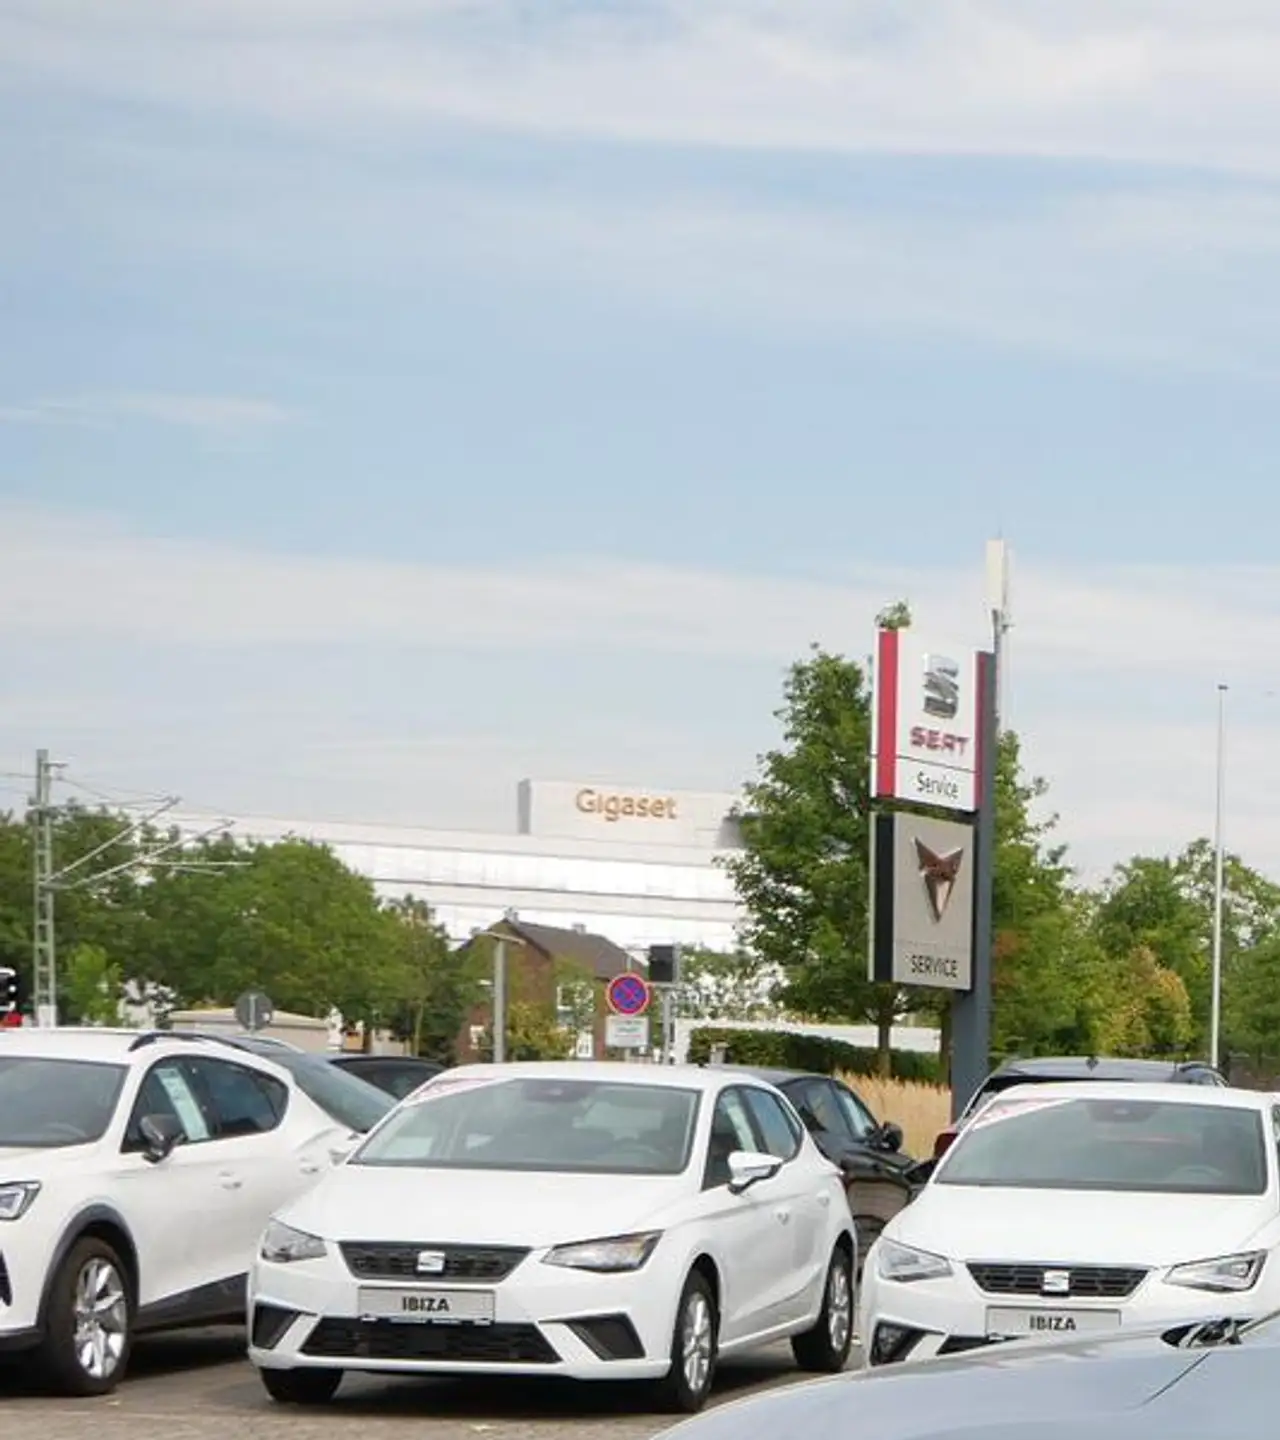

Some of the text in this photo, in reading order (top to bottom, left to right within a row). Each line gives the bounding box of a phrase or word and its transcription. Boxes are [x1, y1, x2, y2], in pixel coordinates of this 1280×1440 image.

[911, 726, 969, 755] SEAT
[917, 771, 959, 799] Service
[576, 788, 677, 822] Gigaset
[911, 954, 958, 978] SERVICE
[402, 1296, 450, 1312] IBIZA
[1030, 1315, 1077, 1331] IBIZA
